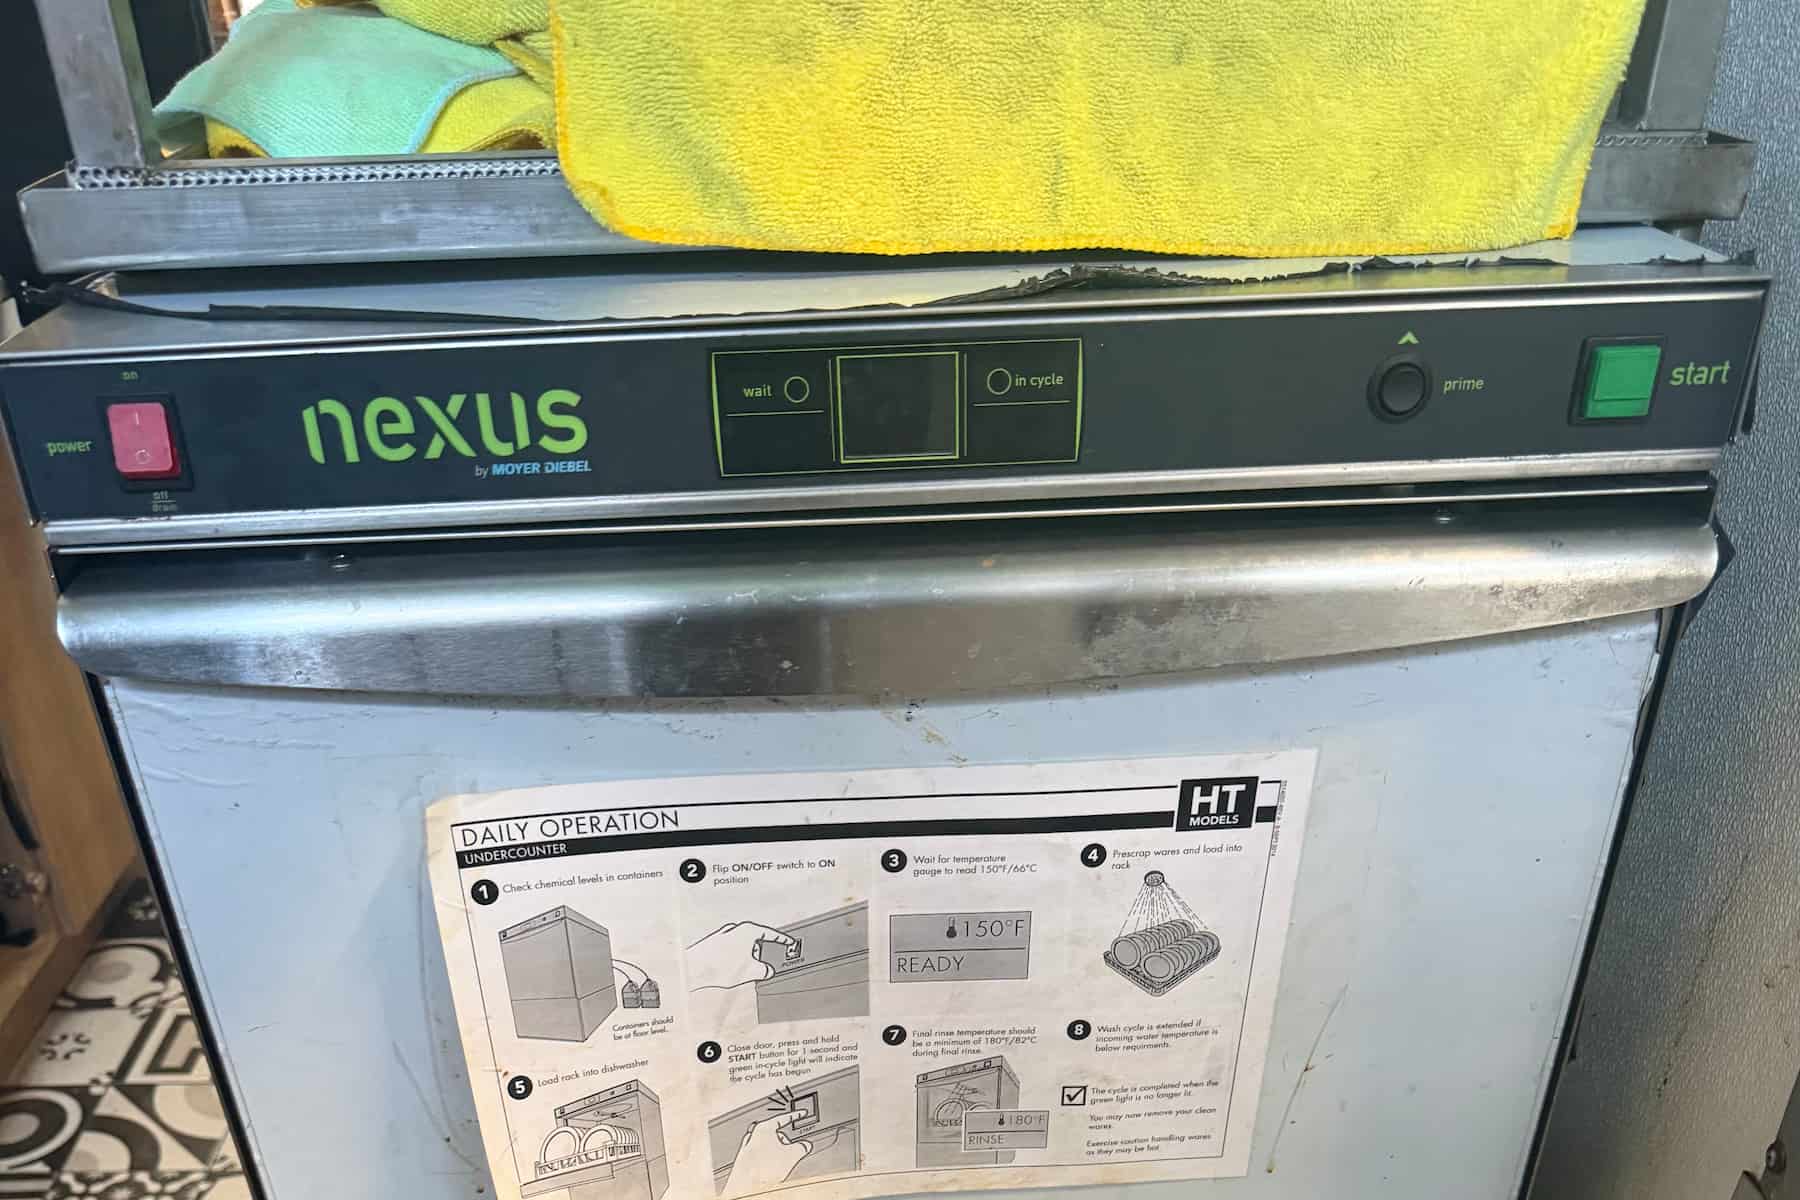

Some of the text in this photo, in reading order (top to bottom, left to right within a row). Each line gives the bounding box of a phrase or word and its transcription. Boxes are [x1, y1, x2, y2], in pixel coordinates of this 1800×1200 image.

[122, 371, 139, 380] on
[1015, 372, 1064, 388] in cycle
[1669, 360, 1731, 386] start
[743, 384, 772, 398] wait
[1443, 376, 1484, 394] prime
[302, 388, 588, 464] nexus
[46, 440, 92, 456] power
[475, 460, 592, 479] by MOYER DIEBEL
[1190, 784, 1246, 815] HT
[1189, 814, 1239, 827] MODELS
[461, 810, 679, 847] DAILY OPERATION
[464, 843, 568, 864] UNDERCOUNTER
[1087, 848, 1099, 862] 4
[1113, 850, 1151, 858] Prescrap
[1203, 845, 1223, 853] load
[1226, 844, 1242, 852] into
[712, 864, 729, 873] Flip
[732, 862, 773, 872] ON/OFF
[777, 861, 804, 870] switch
[818, 859, 835, 868] ON
[888, 854, 900, 867] 3
[913, 855, 1006, 865] Wait for temperature
[1112, 861, 1130, 869] rack
[687, 864, 698, 878] 2
[913, 864, 1038, 878] gauge to read 150°F/66°C
[502, 870, 663, 894] Check chemical levels in containers
[713, 876, 749, 887] position
[479, 886, 489, 899] 1
[964, 919, 1025, 937] 150°F
[897, 955, 965, 973] READY
[612, 1016, 673, 1031] Containers should
[1074, 1024, 1084, 1036] 8
[1097, 1025, 1121, 1033] Wash
[1123, 1024, 1144, 1033] cycle
[1156, 1019, 1193, 1029] extended
[890, 1030, 899, 1040] 7
[913, 1029, 932, 1037] Final
[1161, 1030, 1209, 1038] temperature
[778, 1040, 800, 1048] press
[704, 1046, 714, 1058] 6
[728, 1053, 756, 1063] START
[759, 1051, 785, 1059] button
[787, 1048, 798, 1056] for
[810, 1045, 839, 1053] second
[842, 1043, 858, 1051] and
[912, 1049, 938, 1058] during
[729, 1066, 753, 1074] green
[788, 1058, 806, 1066] light
[808, 1056, 823, 1064] will
[825, 1054, 858, 1062] indicate
[538, 1059, 648, 1087] Load rack into dishwasher
[744, 1073, 766, 1082] cycle
[786, 1068, 811, 1077] begun
[515, 1080, 525, 1094] 5
[1108, 1086, 1128, 1094] cycle
[1139, 1082, 1180, 1091] completed
[1116, 1095, 1133, 1103] light
[968, 1135, 1004, 1145] RINSE
